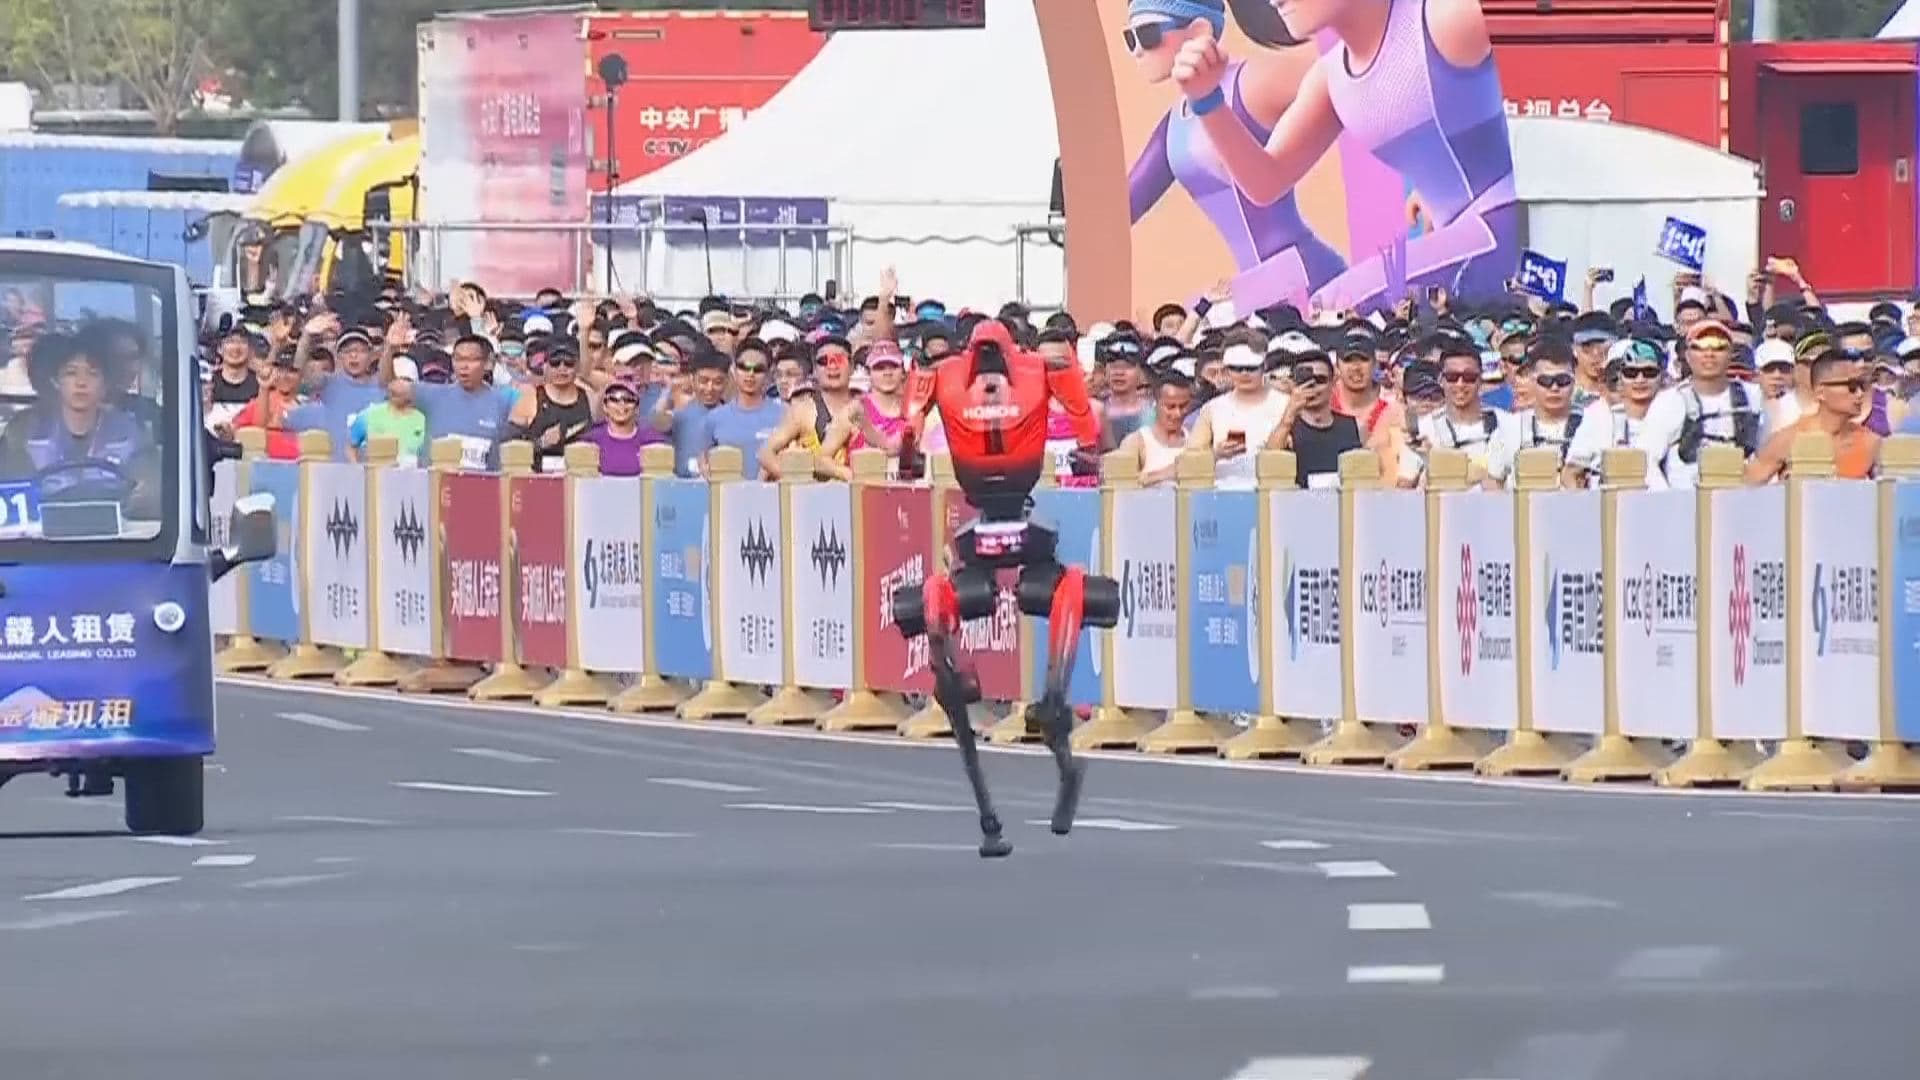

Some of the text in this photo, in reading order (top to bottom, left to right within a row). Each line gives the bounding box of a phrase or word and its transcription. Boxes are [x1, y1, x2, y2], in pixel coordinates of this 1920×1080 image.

[644, 140, 688, 154] CCTV
[1391, 569, 1427, 613] 中国工商银
[0, 613, 136, 645] 器人租赁
